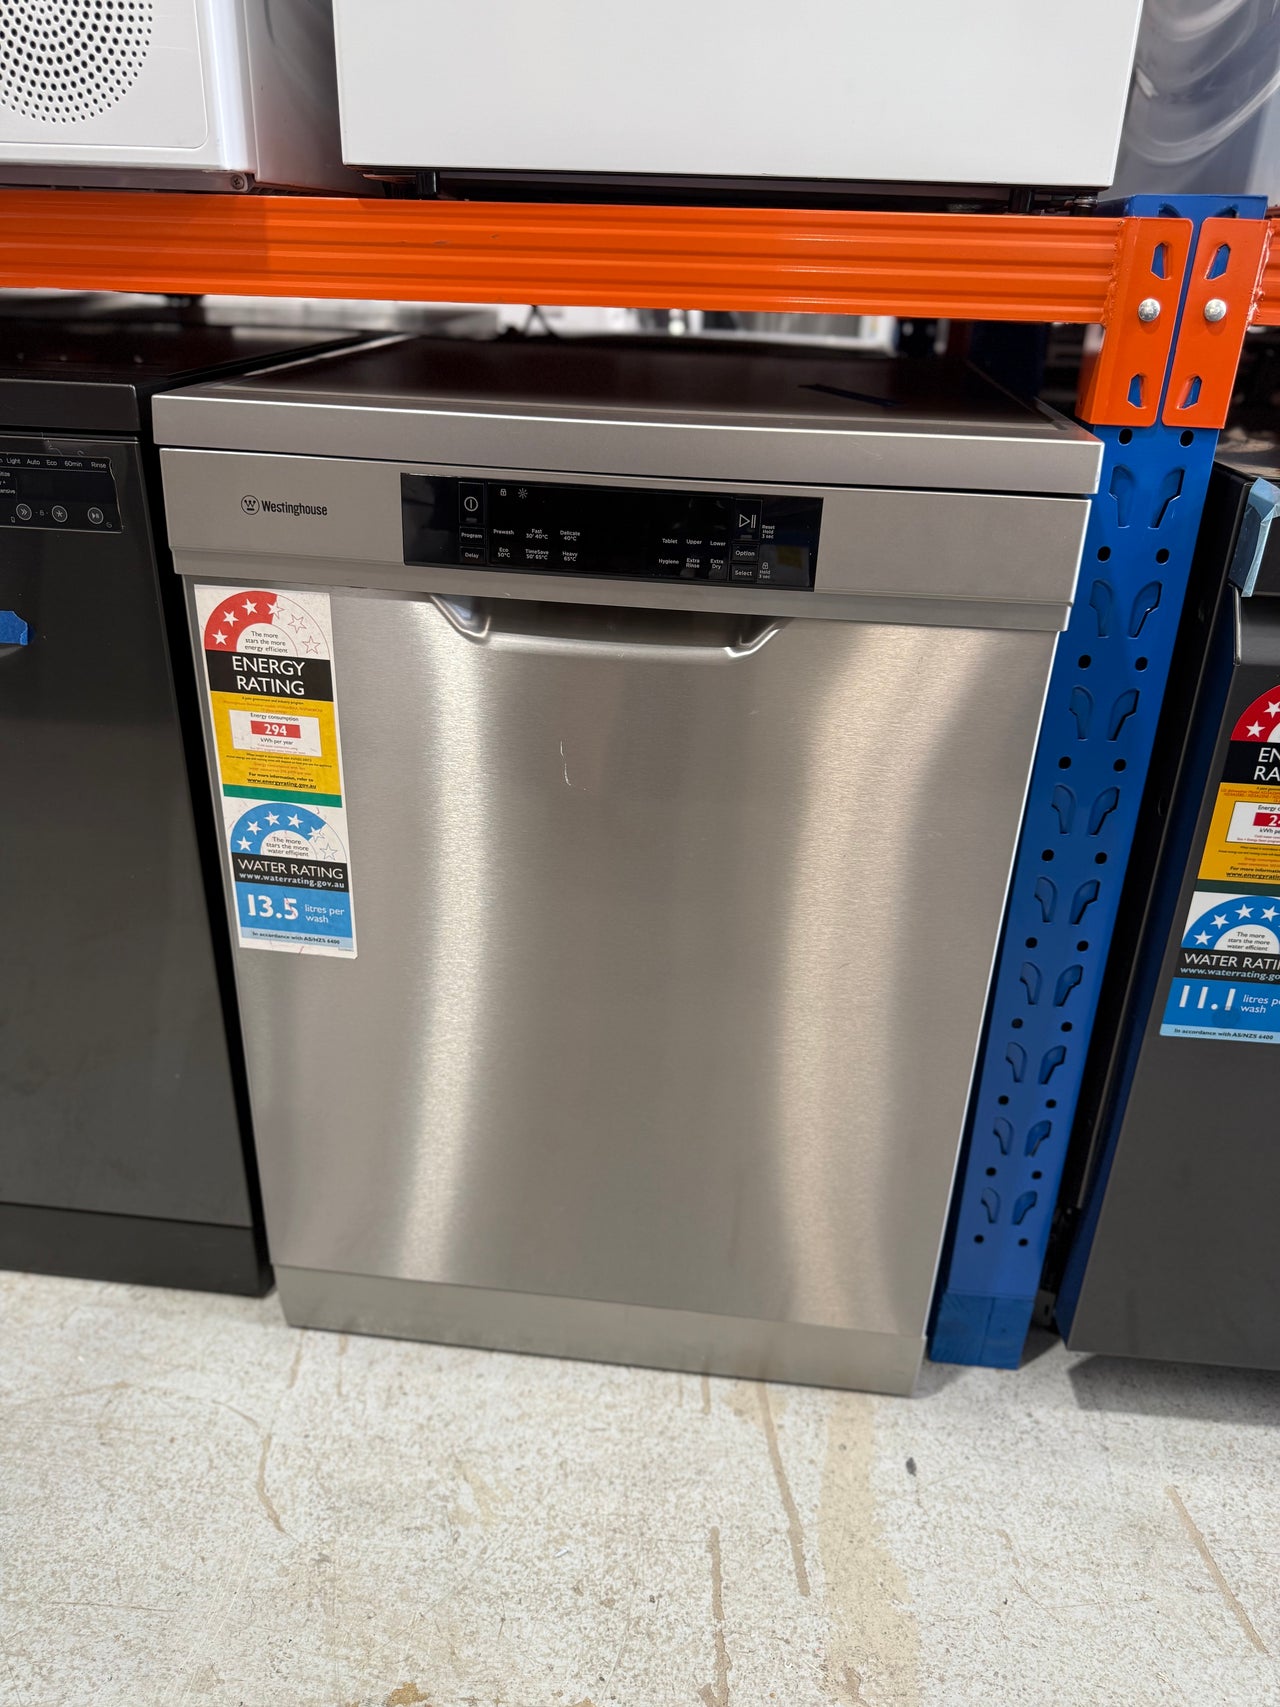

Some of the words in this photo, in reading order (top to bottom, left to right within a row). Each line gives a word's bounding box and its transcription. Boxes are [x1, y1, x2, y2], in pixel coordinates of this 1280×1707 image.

[261, 500, 328, 516] Westinghouse
[232, 655, 305, 676] ENERGY
[236, 675, 305, 695] RATING
[250, 712, 267, 720] Energy
[268, 714, 299, 722] consumption
[264, 724, 287, 736] 294
[1258, 804, 1275, 813] Energy
[285, 849, 309, 857] efficient
[238, 858, 288, 874] WATER
[290, 863, 343, 880] RATING
[239, 872, 345, 888] www.waterrating.gov.au
[247, 893, 299, 921] 13.5
[305, 904, 327, 914] litres
[329, 908, 345, 916] per
[305, 915, 329, 923] wash
[1184, 953, 1237, 967] WATER
[1178, 985, 1236, 1011] 11.1
[1243, 994, 1269, 1004] litres
[1240, 1005, 1266, 1013] wash
[1182, 1028, 1216, 1036] accordance
